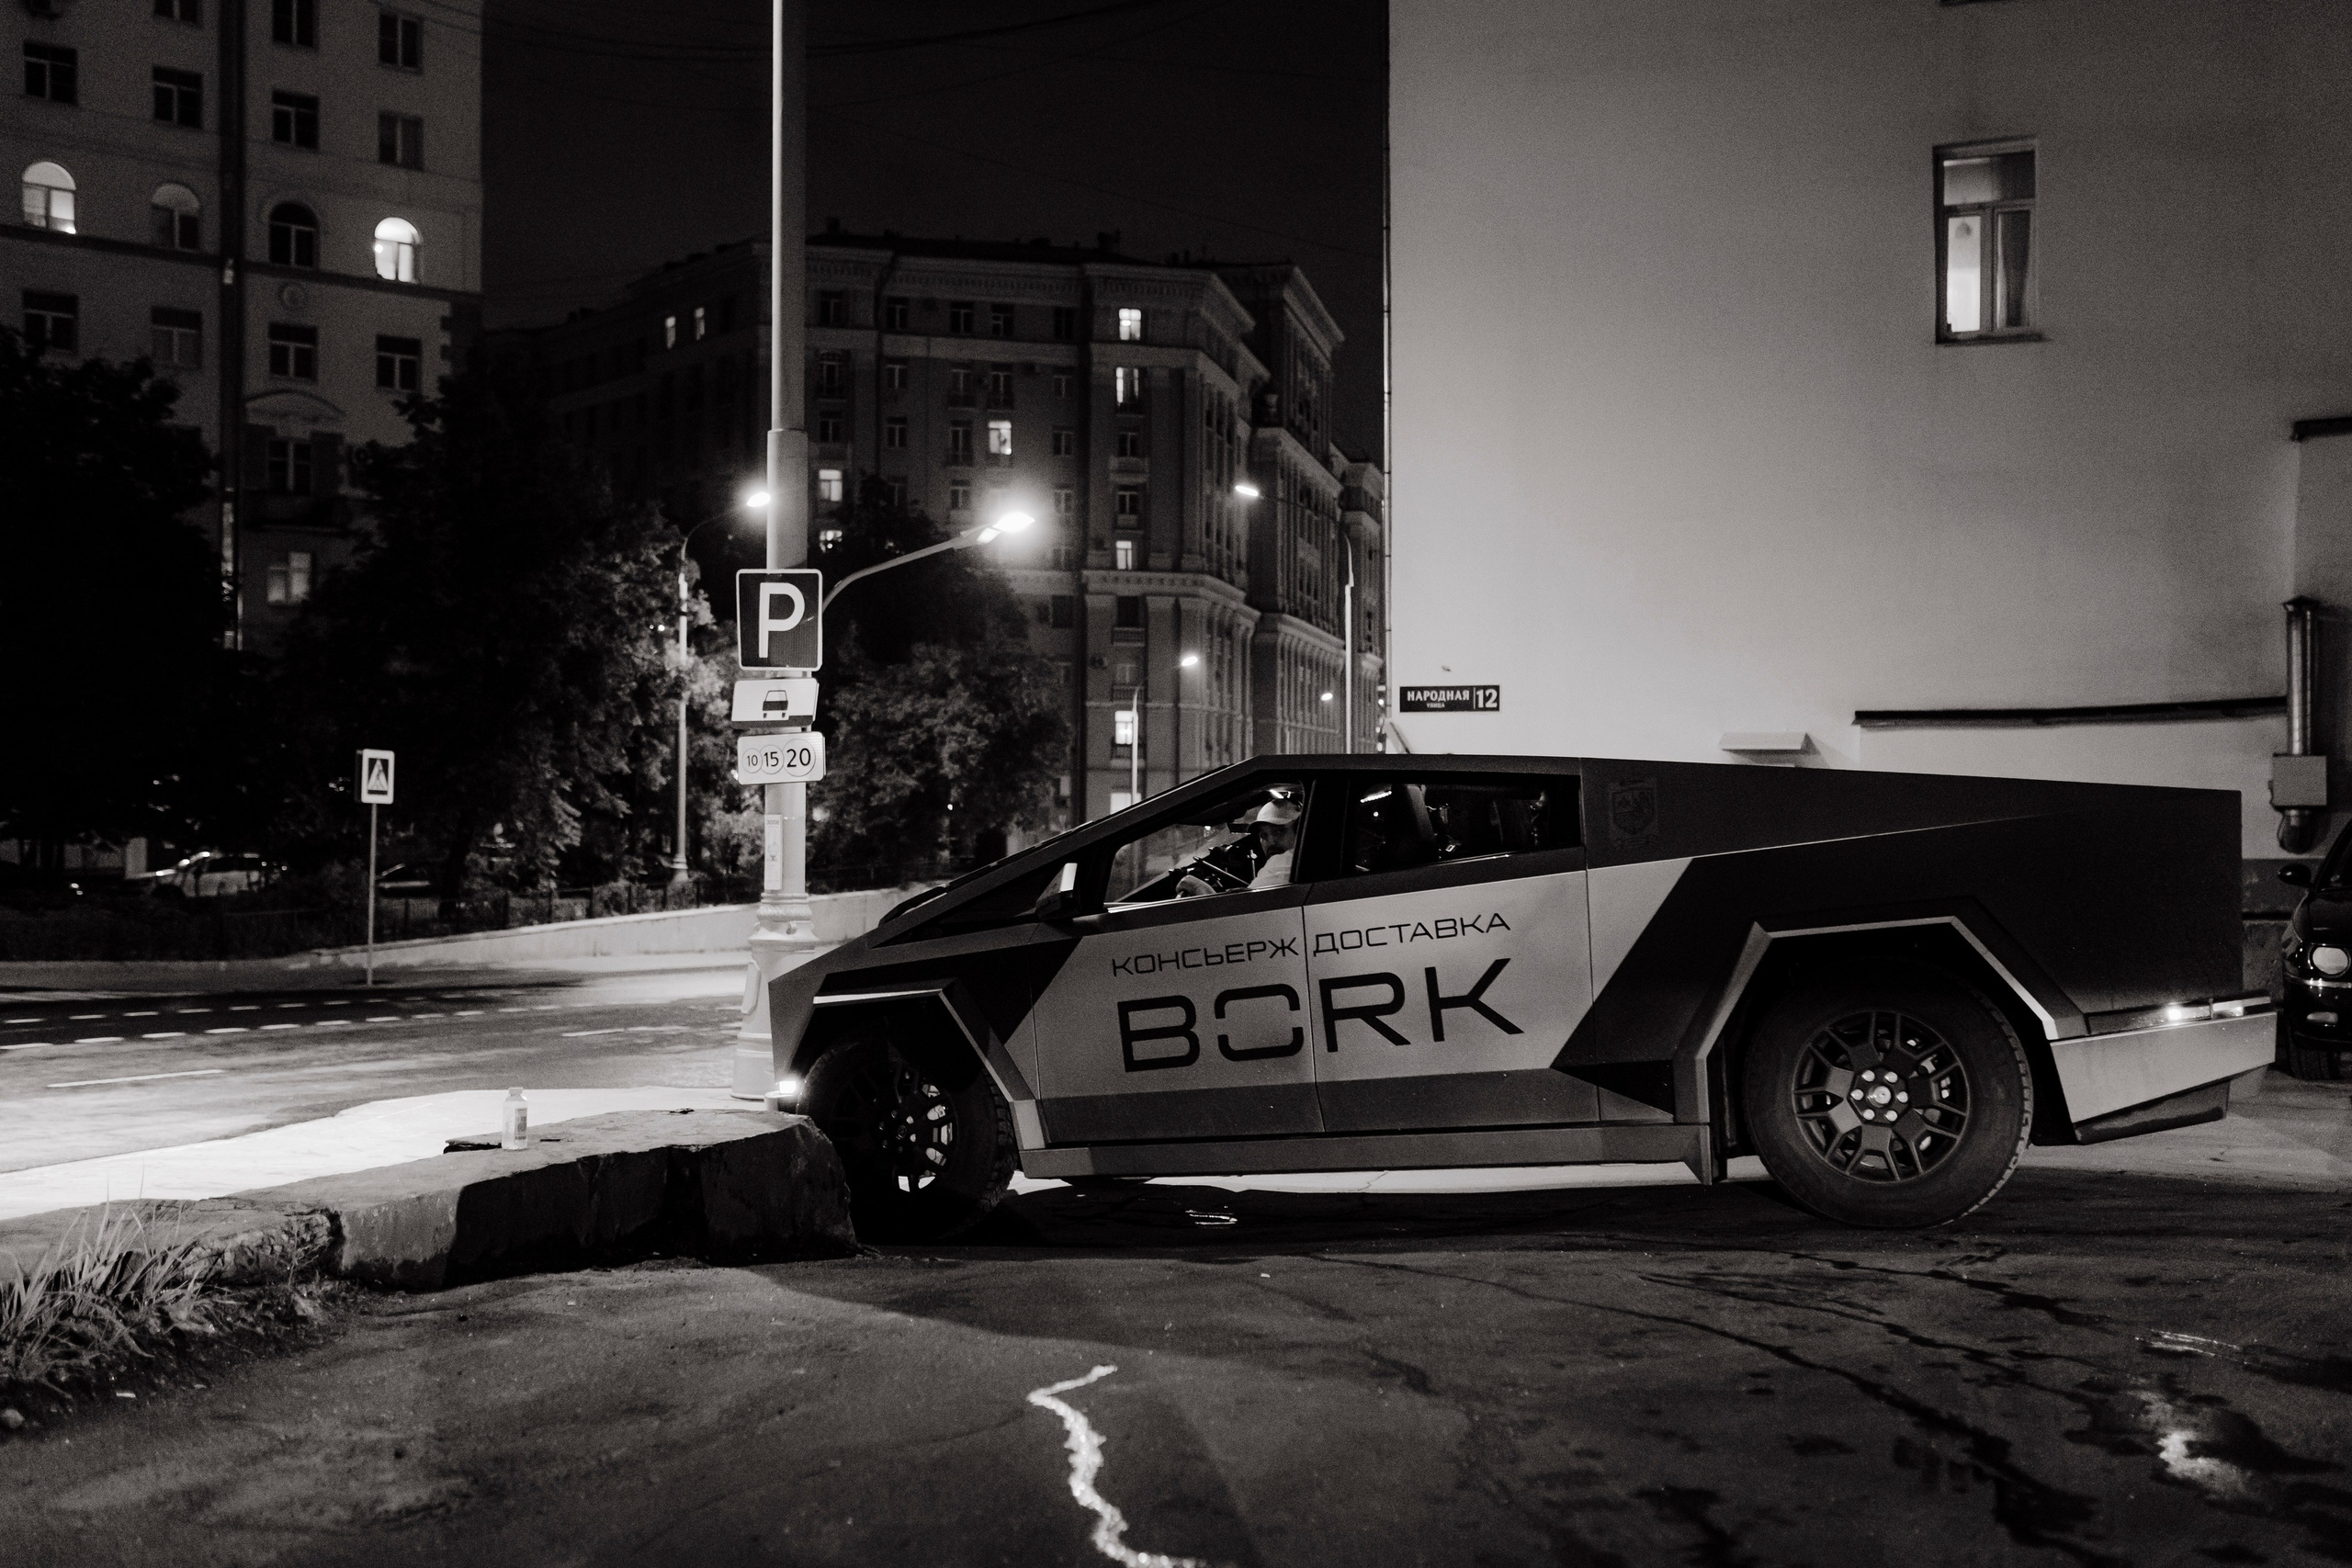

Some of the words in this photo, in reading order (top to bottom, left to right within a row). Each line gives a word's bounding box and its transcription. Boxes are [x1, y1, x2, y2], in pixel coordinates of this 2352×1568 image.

[759, 581, 805, 658] P
[1407, 690, 1470, 702] НАРОДНАЯ
[1476, 688, 1498, 708] 12
[746, 754, 758, 767] 10
[763, 751, 779, 767] 15
[786, 748, 811, 768] 20
[1112, 936, 1298, 977] КОНСЬЕРЖ
[1313, 912, 1511, 957] ДОСТАВКА
[1116, 957, 1525, 1073] BORK
